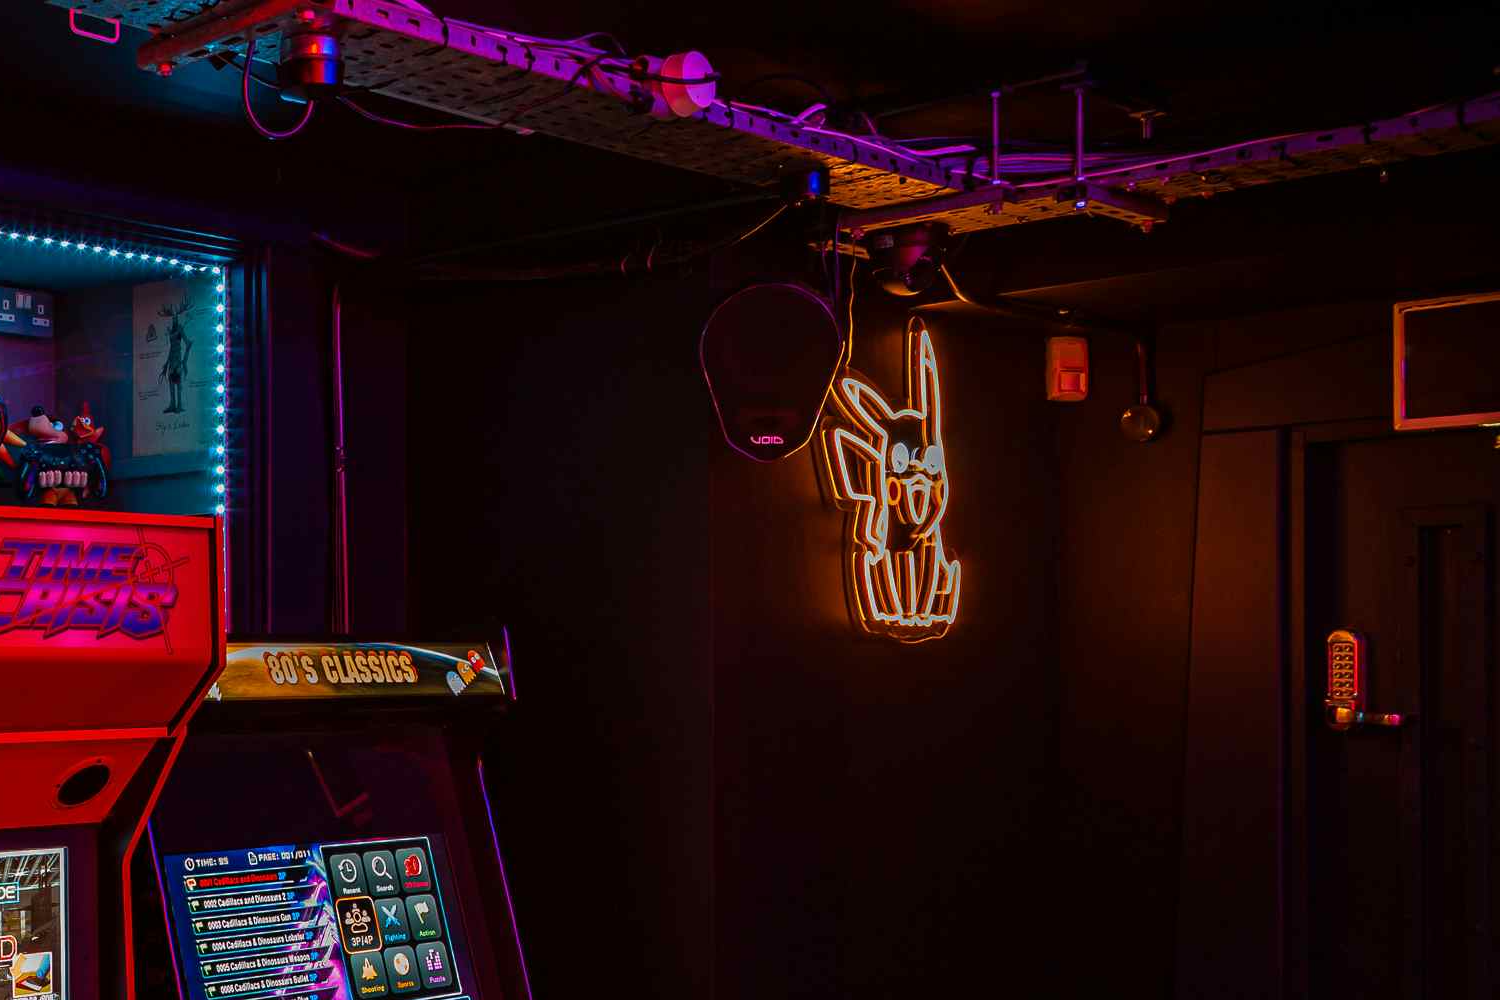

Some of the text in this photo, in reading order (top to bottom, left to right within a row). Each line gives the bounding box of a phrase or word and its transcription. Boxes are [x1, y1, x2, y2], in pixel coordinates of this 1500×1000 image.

[750, 435, 784, 445] VOID
[0, 537, 143, 582] TIME
[263, 650, 419, 685] 80'S CLASSICS
[258, 853, 280, 862] PAGE:
[195, 858, 217, 868] TIME:
